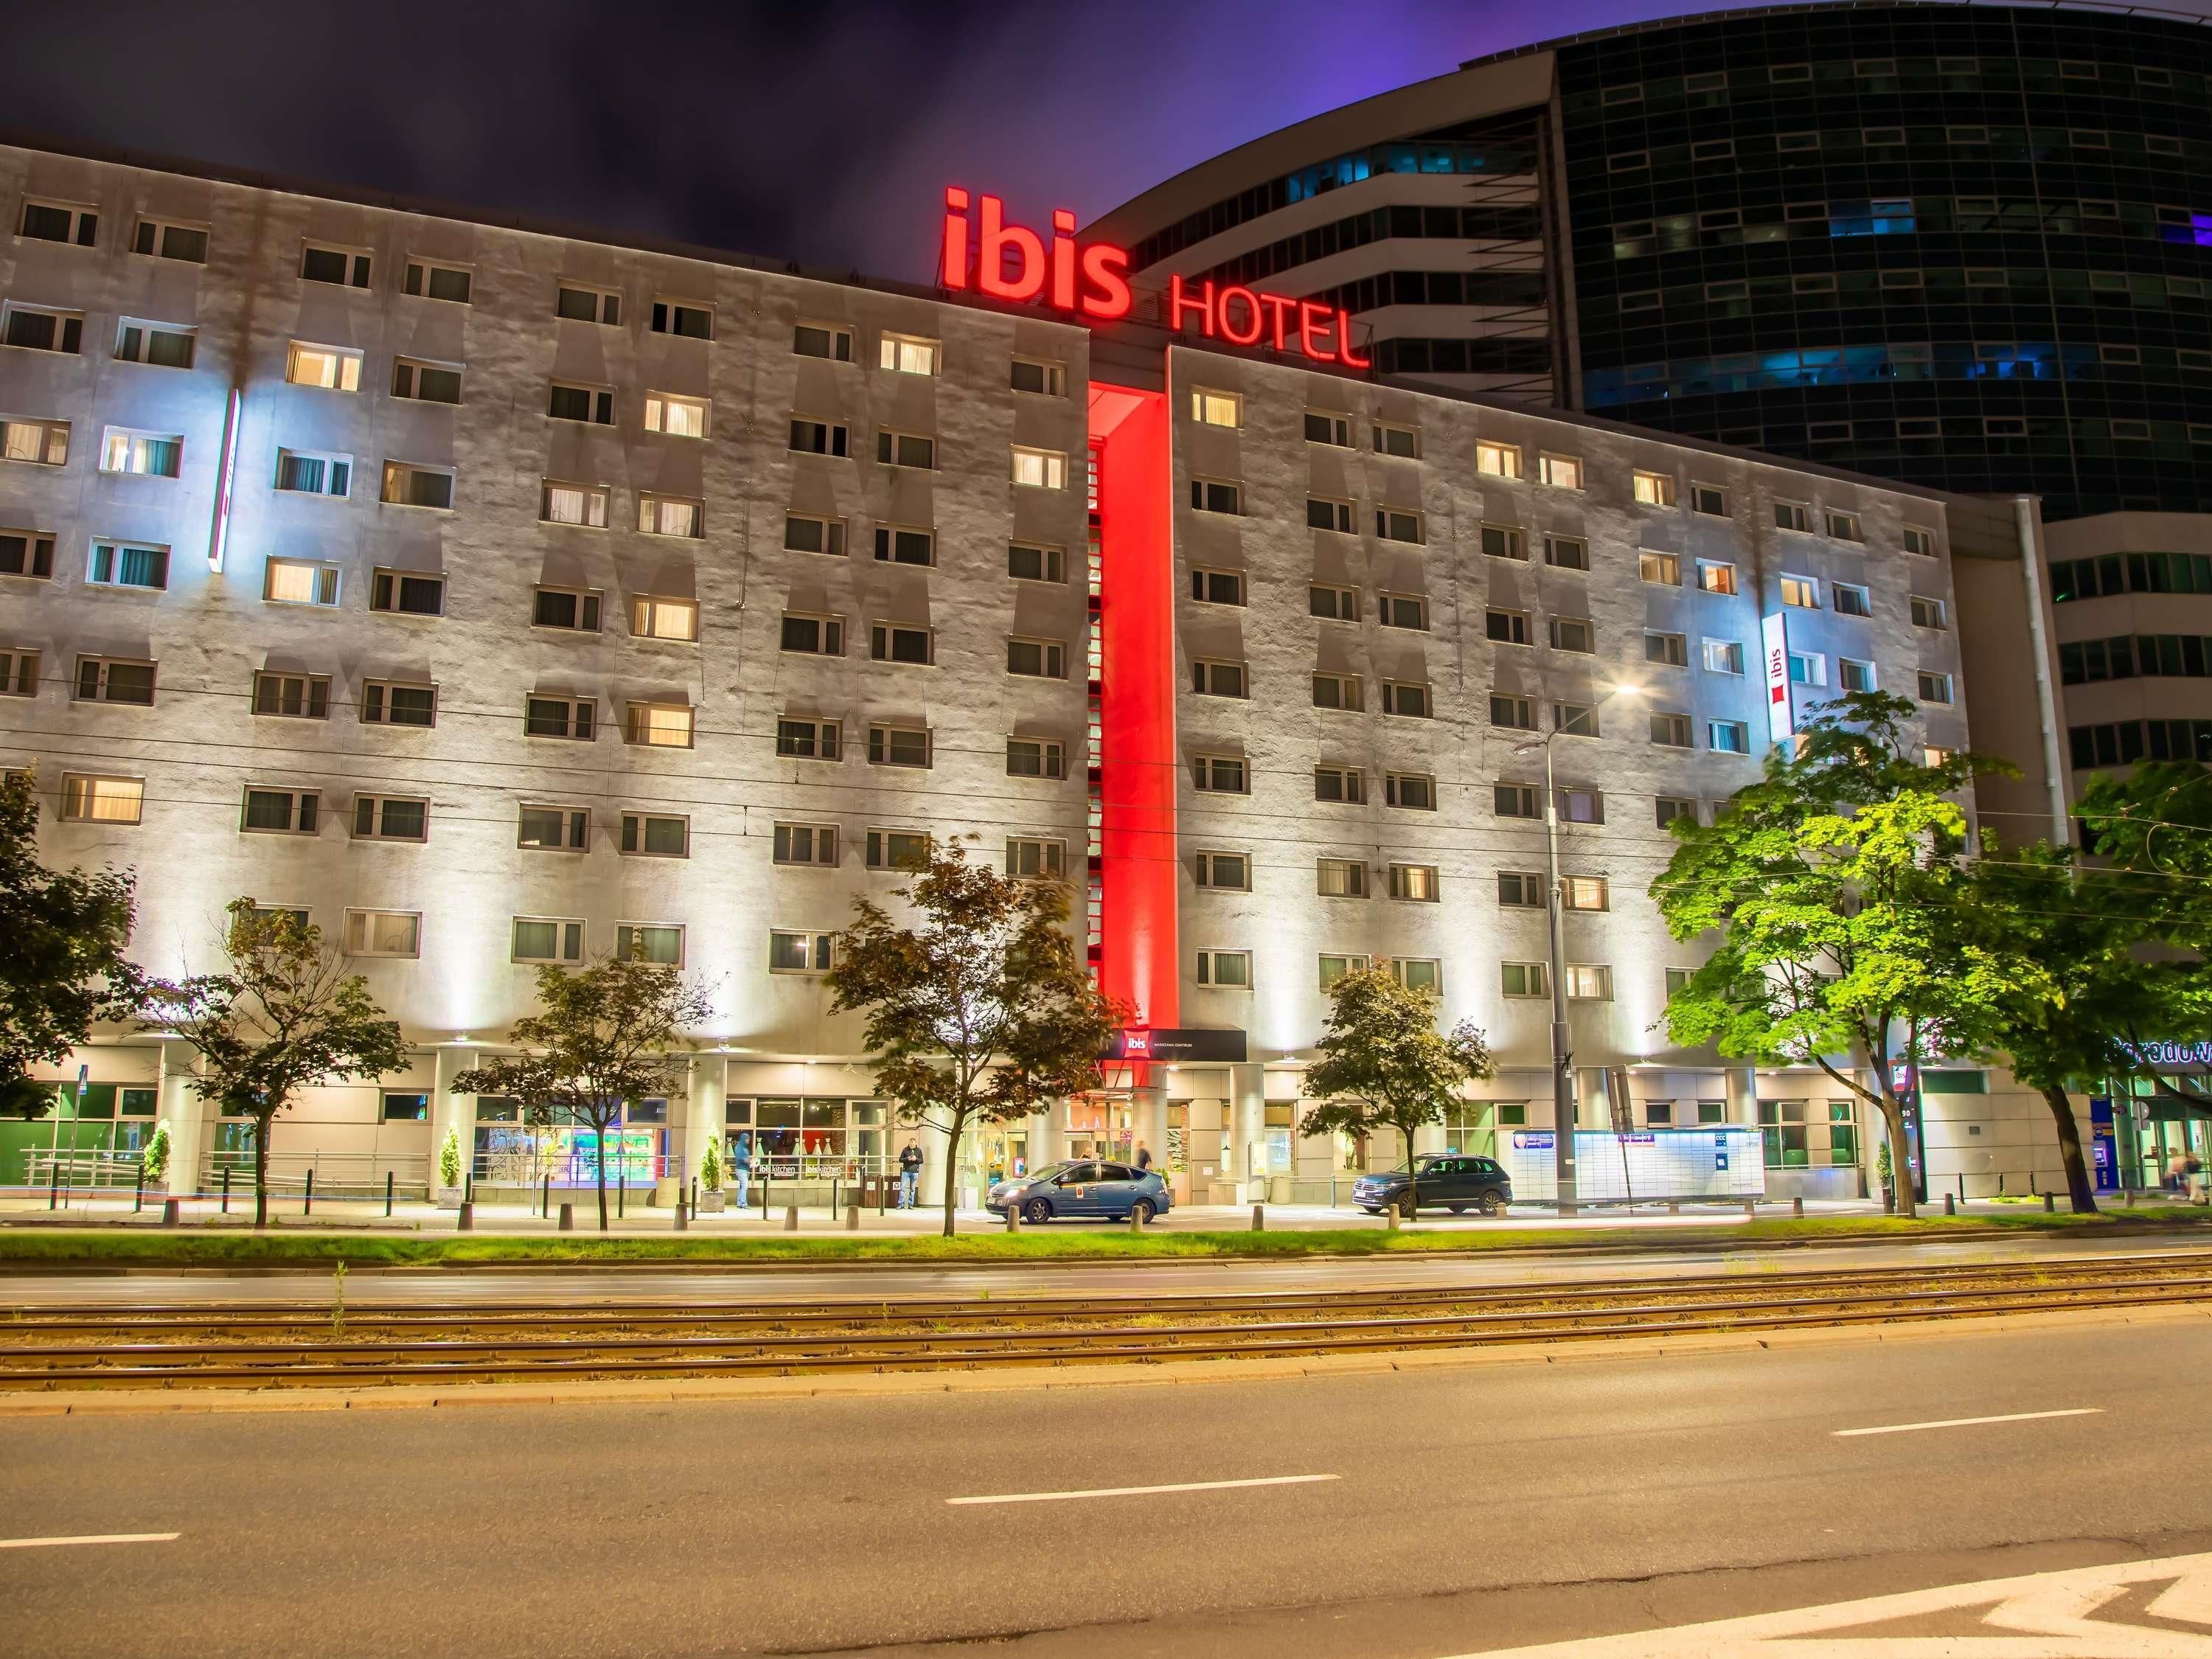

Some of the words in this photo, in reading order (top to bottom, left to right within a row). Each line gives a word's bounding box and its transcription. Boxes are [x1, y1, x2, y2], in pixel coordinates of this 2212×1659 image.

[943, 186, 1130, 319] ibis
[1169, 273, 1371, 368] HOTEL
[1770, 648, 1781, 678] ibis
[1128, 1037, 1146, 1049] ibis
